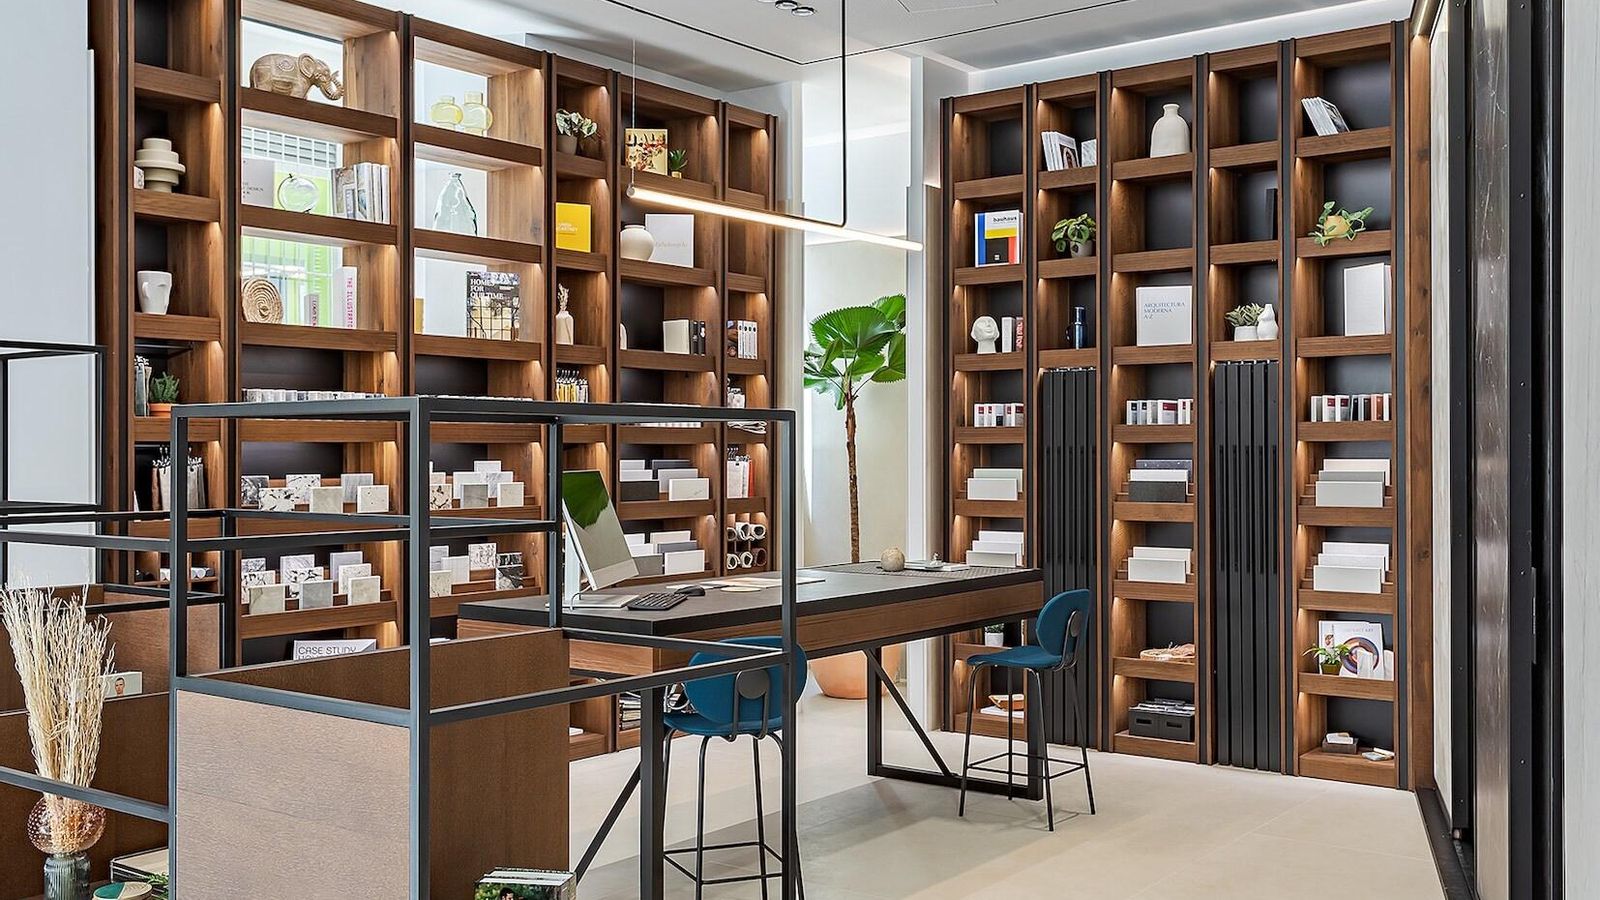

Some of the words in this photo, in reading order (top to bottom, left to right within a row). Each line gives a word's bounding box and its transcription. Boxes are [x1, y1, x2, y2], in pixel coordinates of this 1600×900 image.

[470, 278, 495, 287] HOMES
[298, 646, 323, 655] CASE
[326, 646, 357, 655] STUDY
